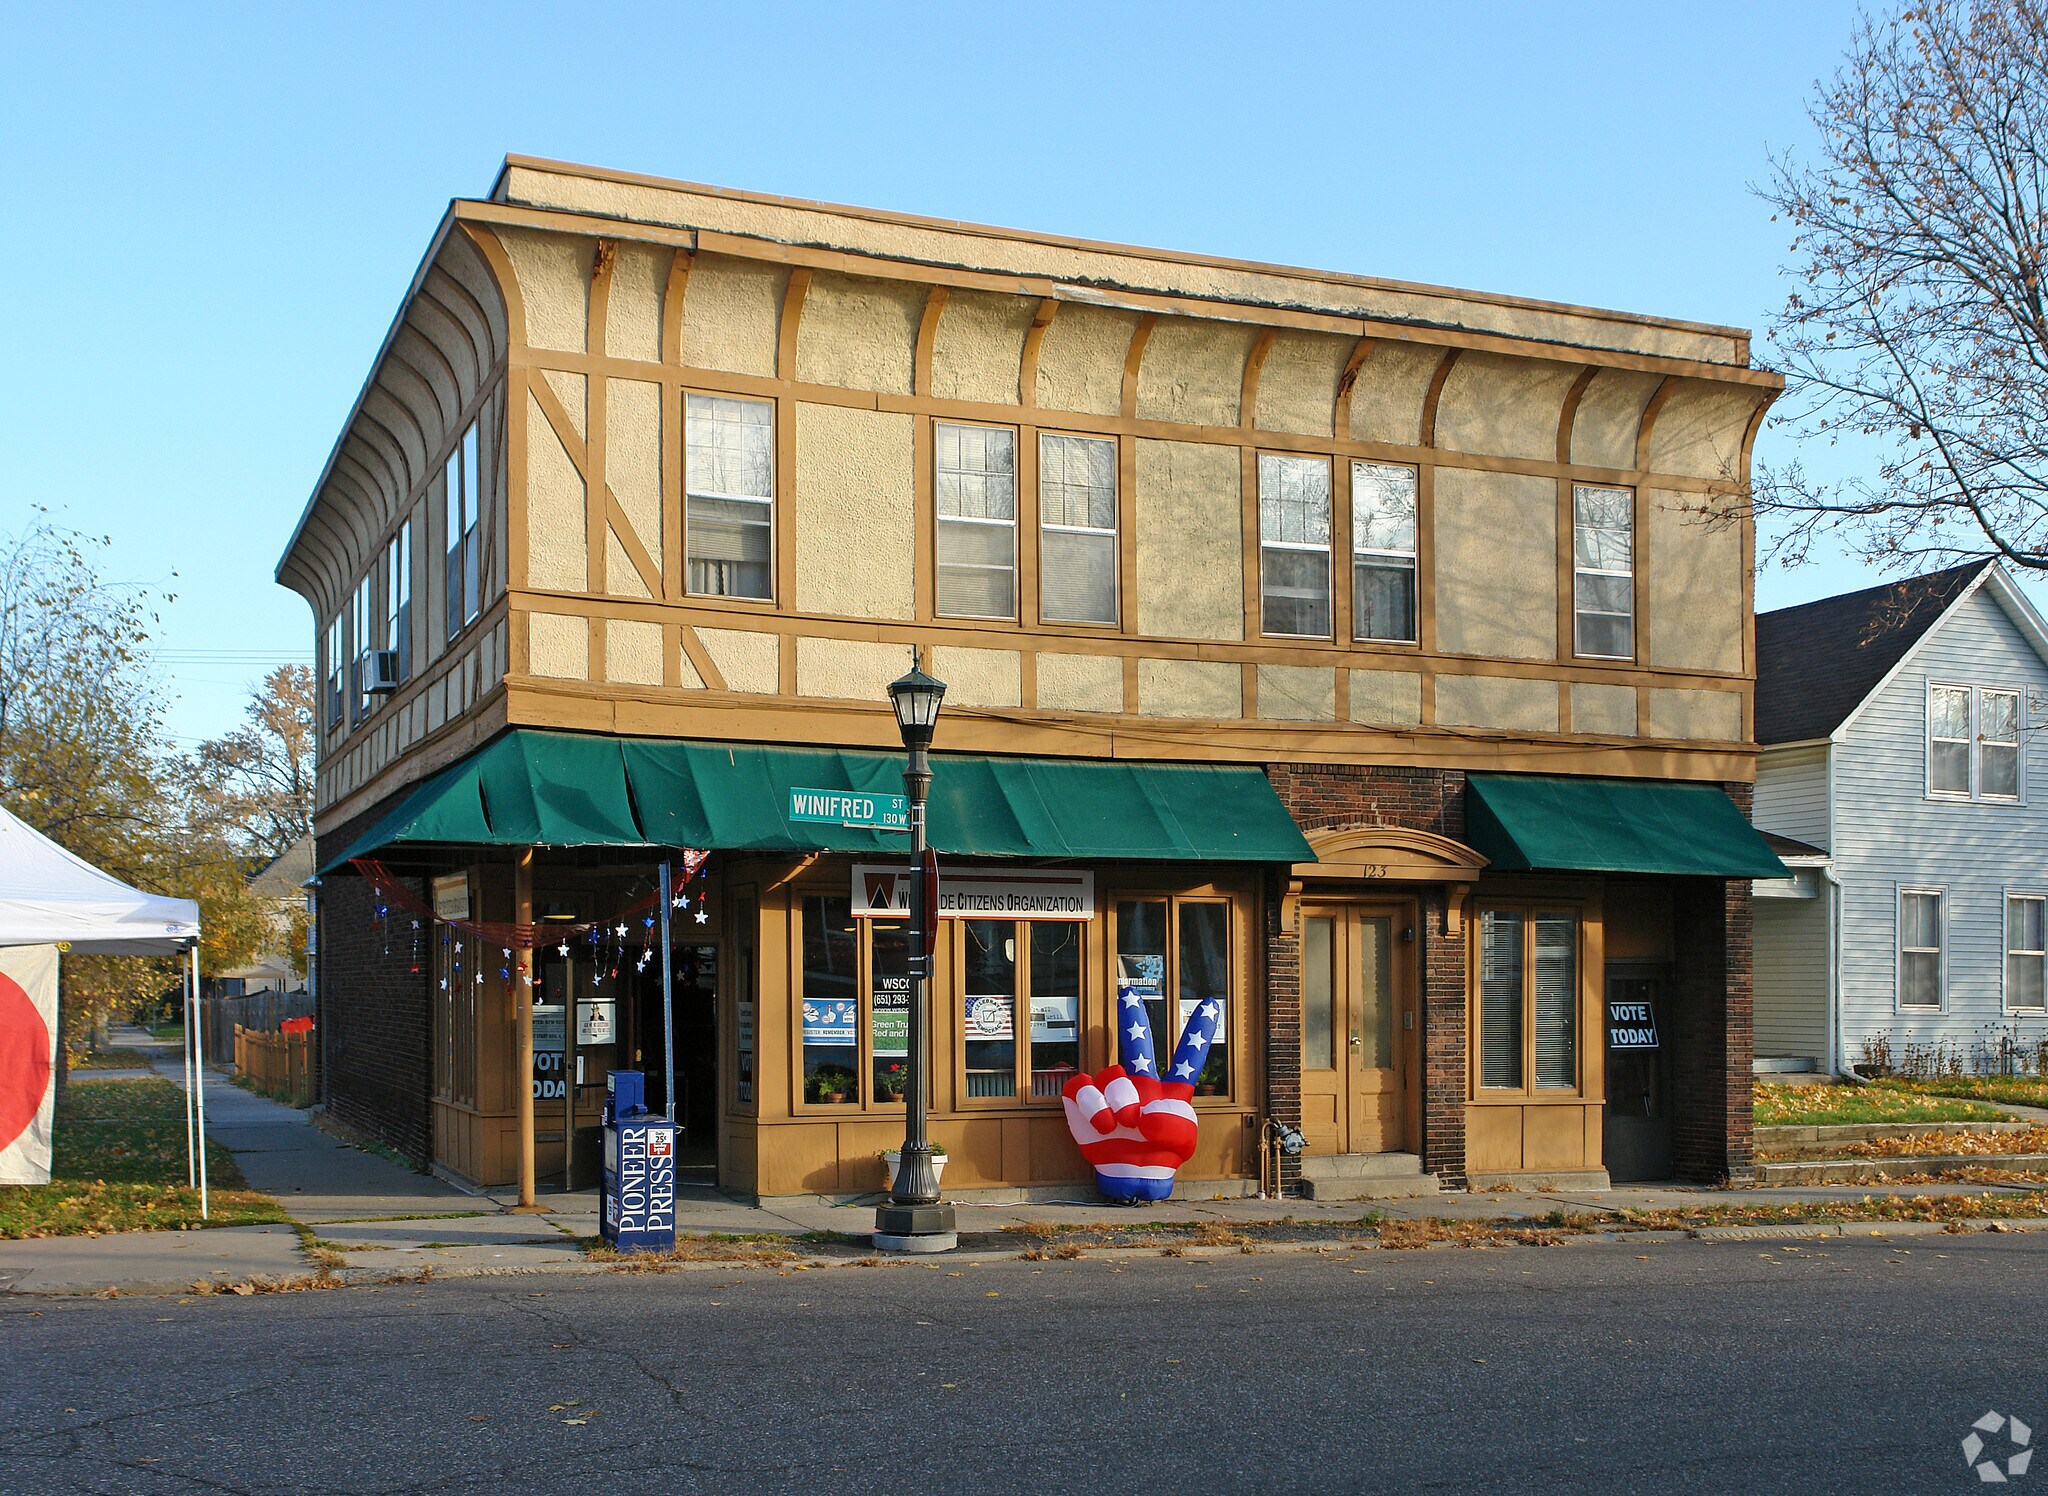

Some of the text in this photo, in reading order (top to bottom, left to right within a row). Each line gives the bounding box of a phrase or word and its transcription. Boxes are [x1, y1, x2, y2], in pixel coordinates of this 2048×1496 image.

[793, 794, 903, 819] WINIFRED ST
[882, 813, 907, 825] 130 W
[1363, 864, 1387, 878] 123
[958, 892, 1004, 911] CITIZENS
[1007, 893, 1083, 912] ORGANIZATION
[1118, 977, 1157, 986] nformation
[874, 994, 891, 1006] (651)
[1610, 1005, 1648, 1021] VOTE
[872, 1020, 895, 1028] Green
[872, 1029, 888, 1037] Red
[889, 1029, 904, 1037] and
[1610, 1028, 1654, 1044] TODAY
[619, 1126, 645, 1233] PIONEER
[647, 1156, 673, 1232] PRESS
